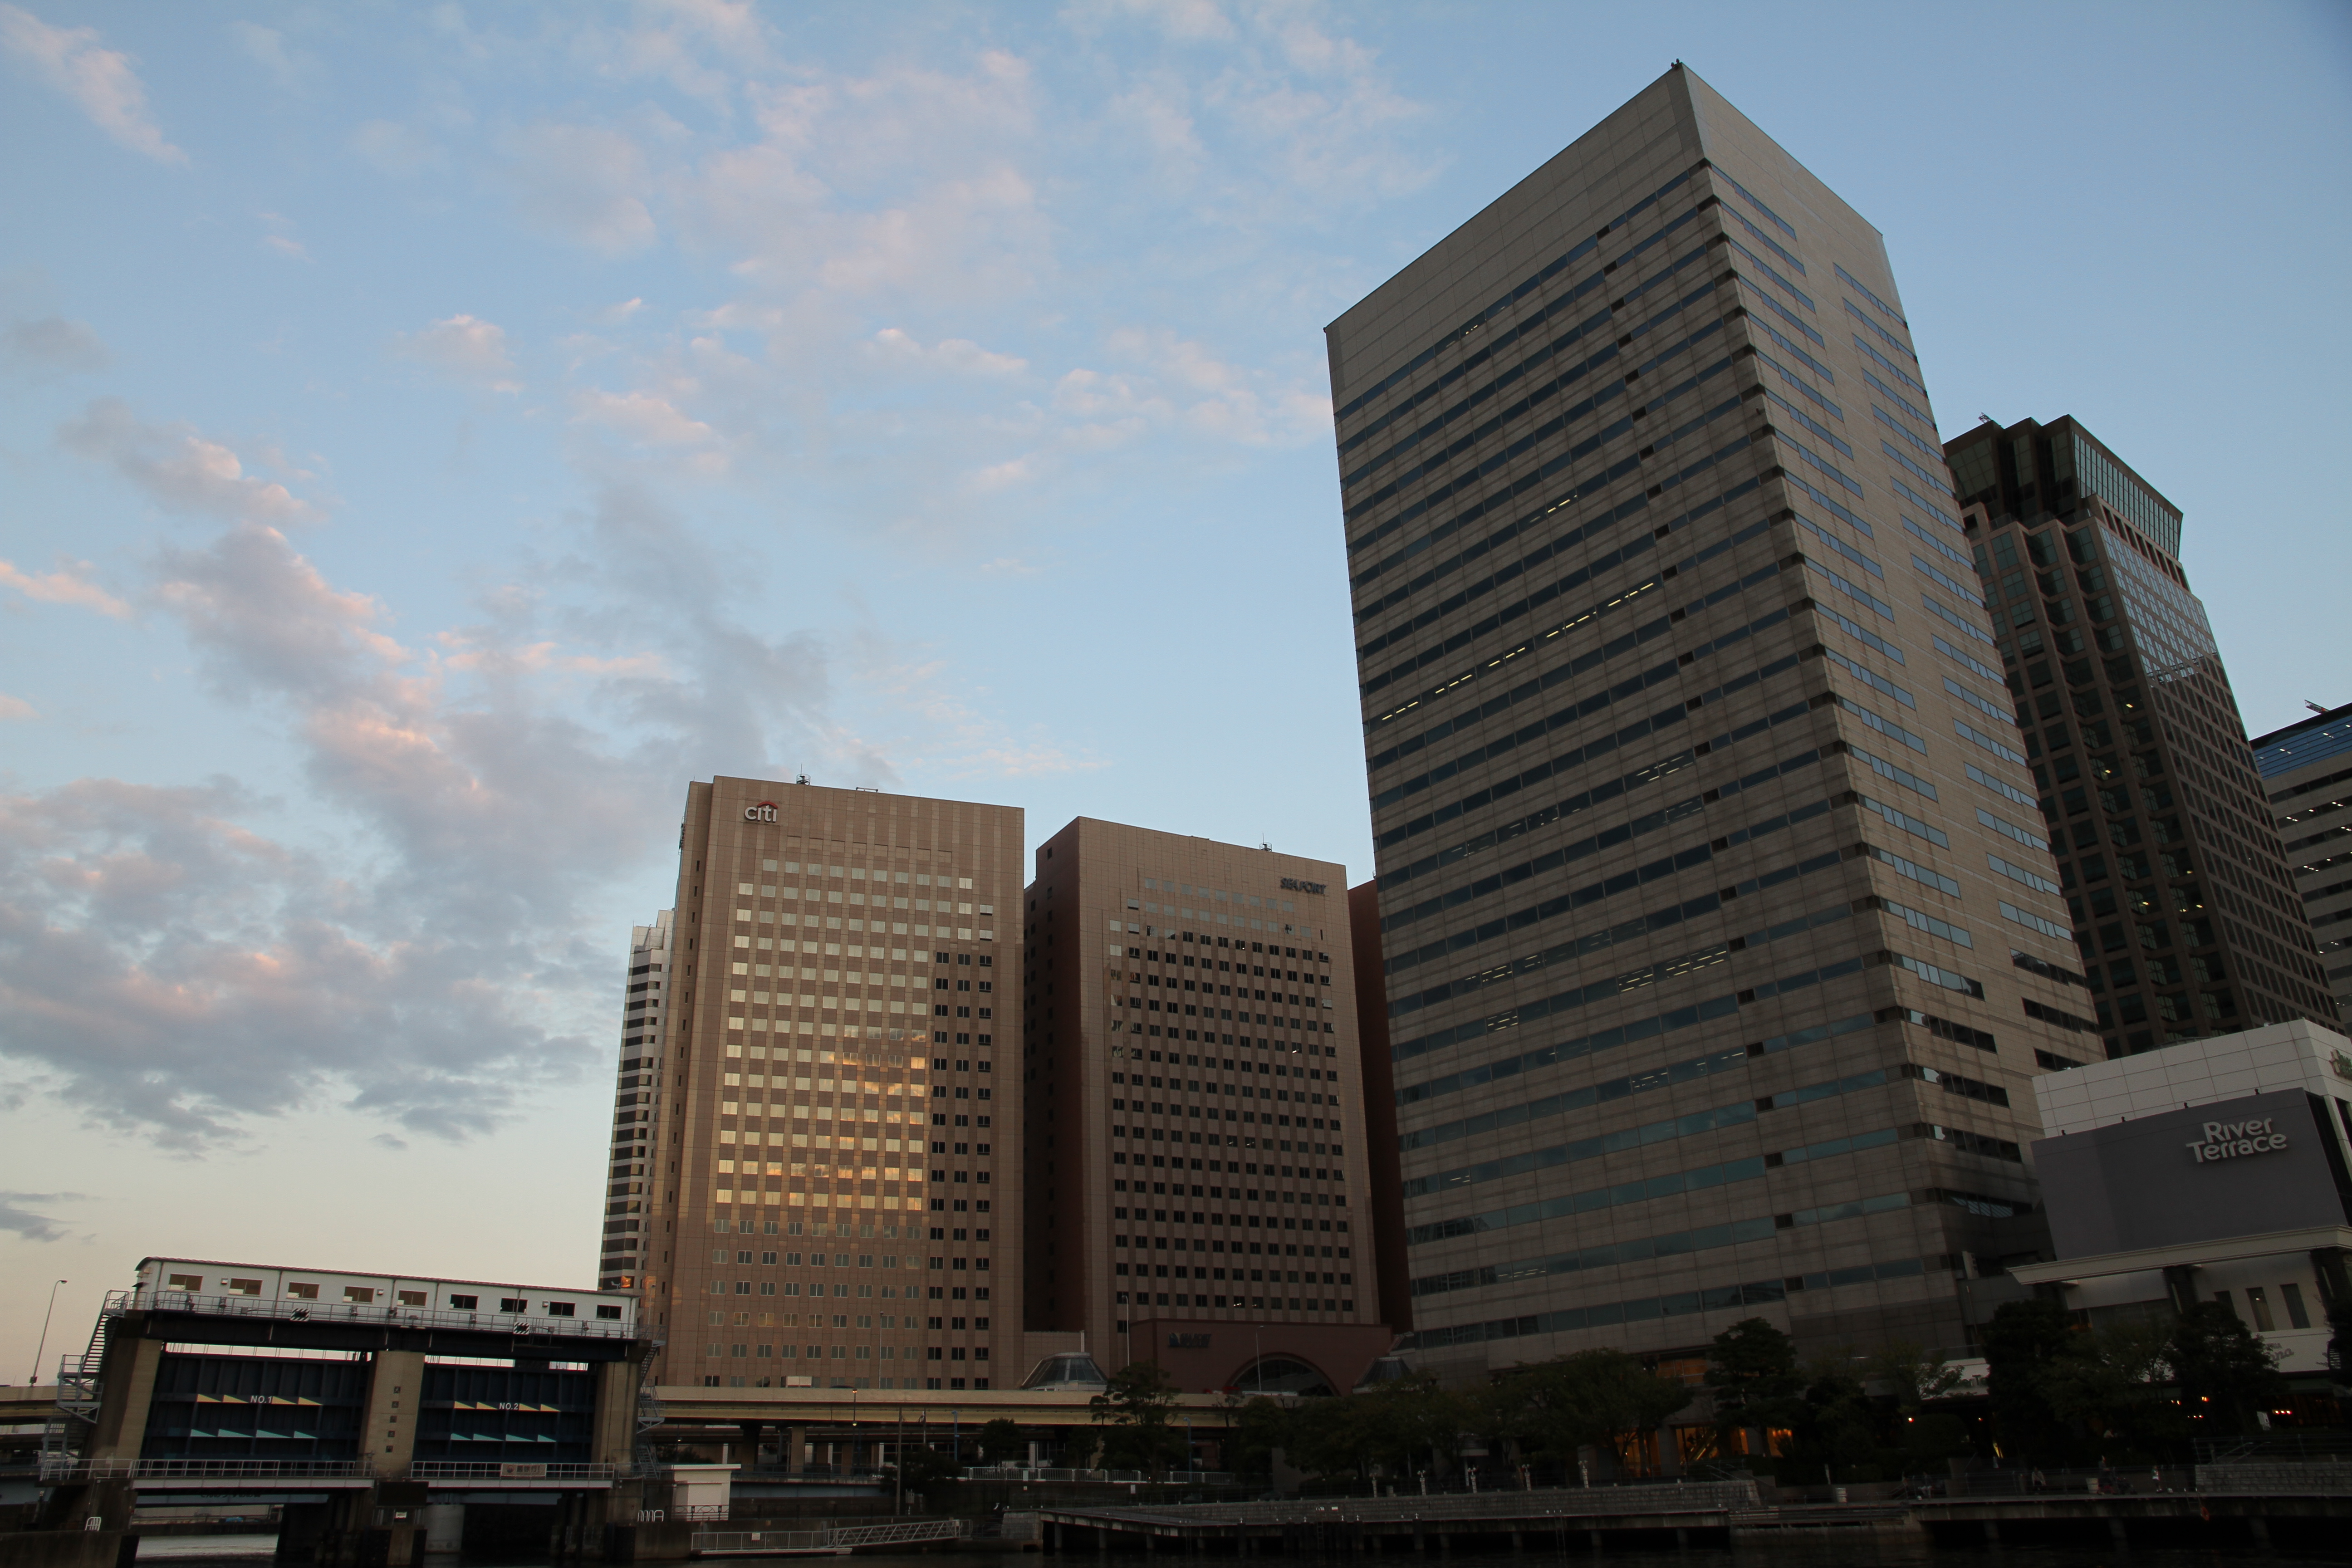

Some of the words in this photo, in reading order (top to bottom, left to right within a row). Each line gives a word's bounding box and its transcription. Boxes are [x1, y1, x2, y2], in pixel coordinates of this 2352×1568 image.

[745, 801, 778, 823] citi
[2202, 1117, 2273, 1143] River
[2185, 1133, 2288, 1163] Terrace
[250, 1395, 272, 1403] NO.1
[499, 1402, 519, 1410] NO.2
